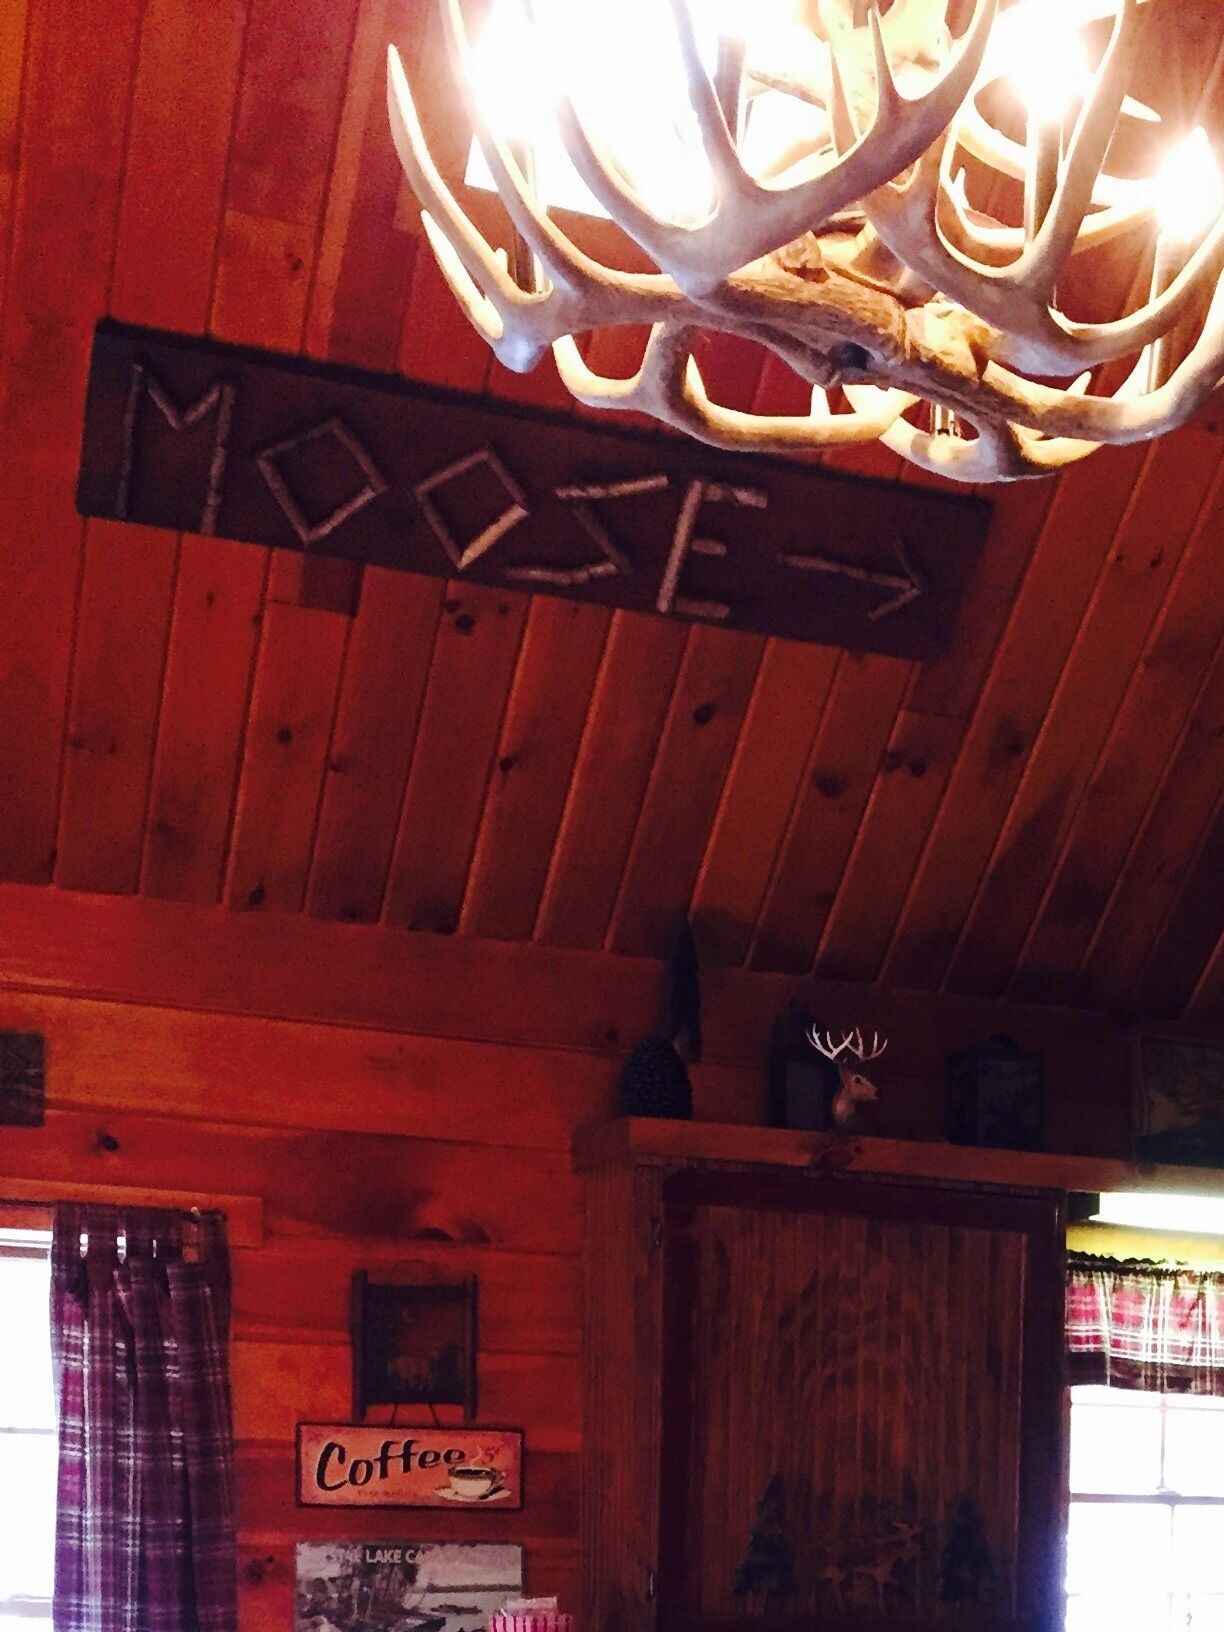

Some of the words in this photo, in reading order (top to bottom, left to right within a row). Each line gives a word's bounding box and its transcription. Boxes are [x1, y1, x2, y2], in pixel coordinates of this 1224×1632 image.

[115, 363, 770, 618] MOOSE
[316, 1439, 466, 1491] Coffee
[366, 1549, 402, 1564] LAKE
